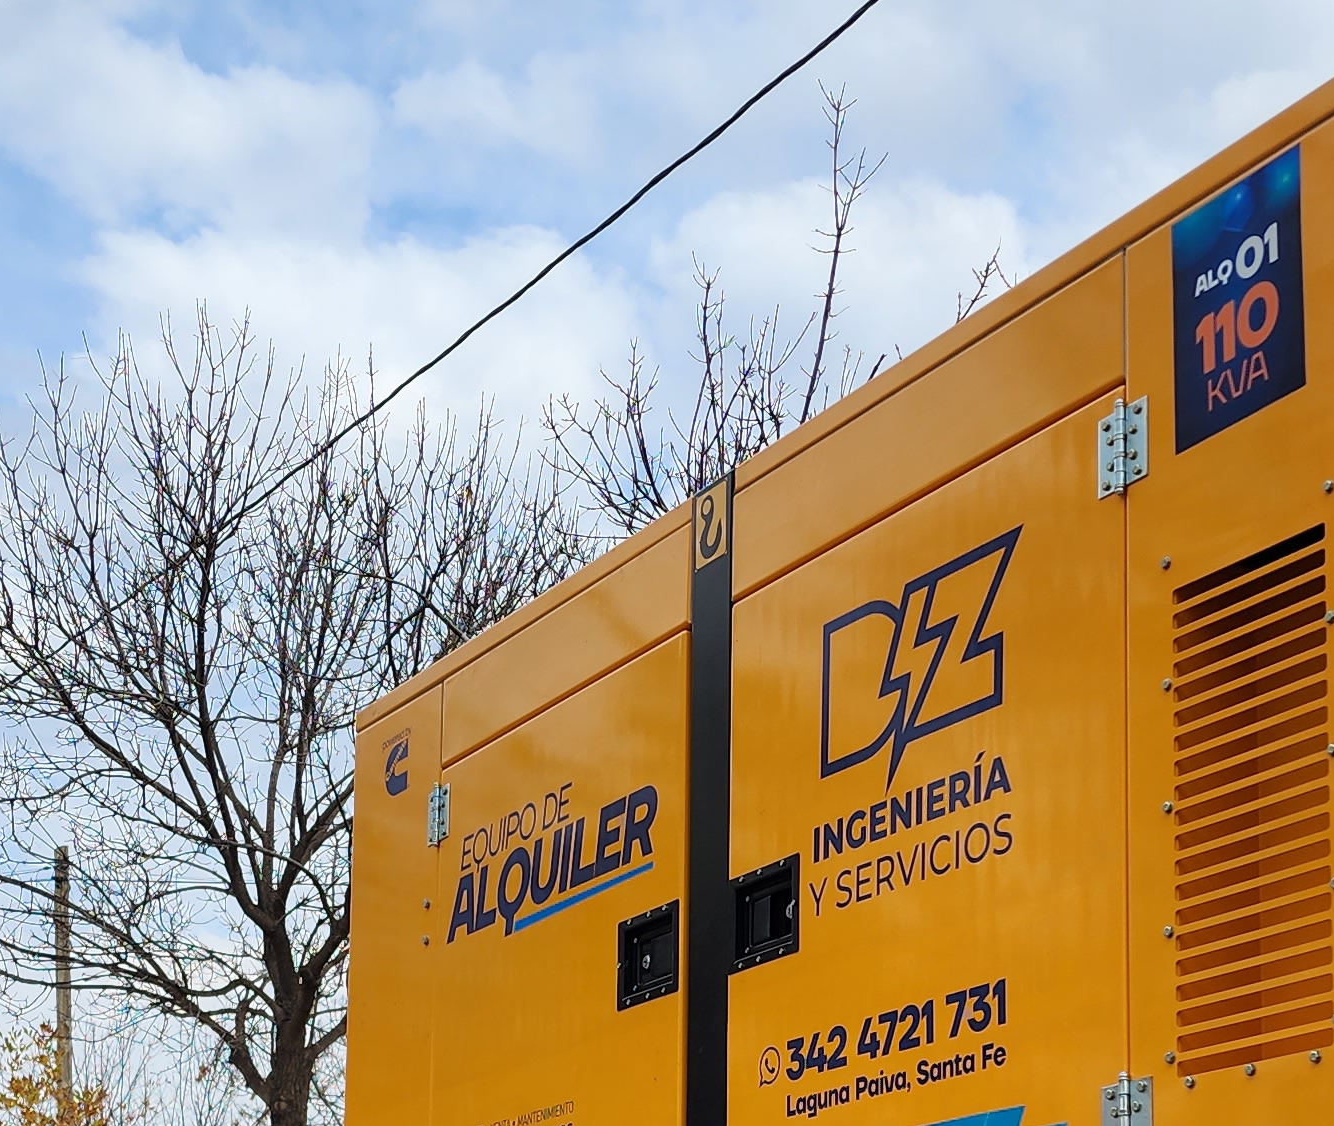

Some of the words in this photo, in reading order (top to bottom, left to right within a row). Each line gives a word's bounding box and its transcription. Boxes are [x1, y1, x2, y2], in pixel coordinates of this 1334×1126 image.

[1195, 280, 1280, 375] 110
[1207, 350, 1269, 411] KVA
[460, 802, 537, 873] EQUIPO
[542, 782, 573, 831] DE
[812, 750, 1011, 863] INGENIERÍA
[446, 785, 658, 944] ALQUILER
[808, 876, 828, 917] Y
[835, 813, 1013, 909] SERVICIOS
[785, 1025, 848, 1081] 342
[857, 999, 934, 1059] 4721
[945, 978, 1006, 1039] 731
[517, 1100, 574, 1126] MANTENIMIENTO
[786, 1082, 850, 1118] Laguna
[855, 1070, 911, 1100] Paiva,
[916, 1050, 975, 1085] Santa
[982, 1043, 1006, 1070] Fe
